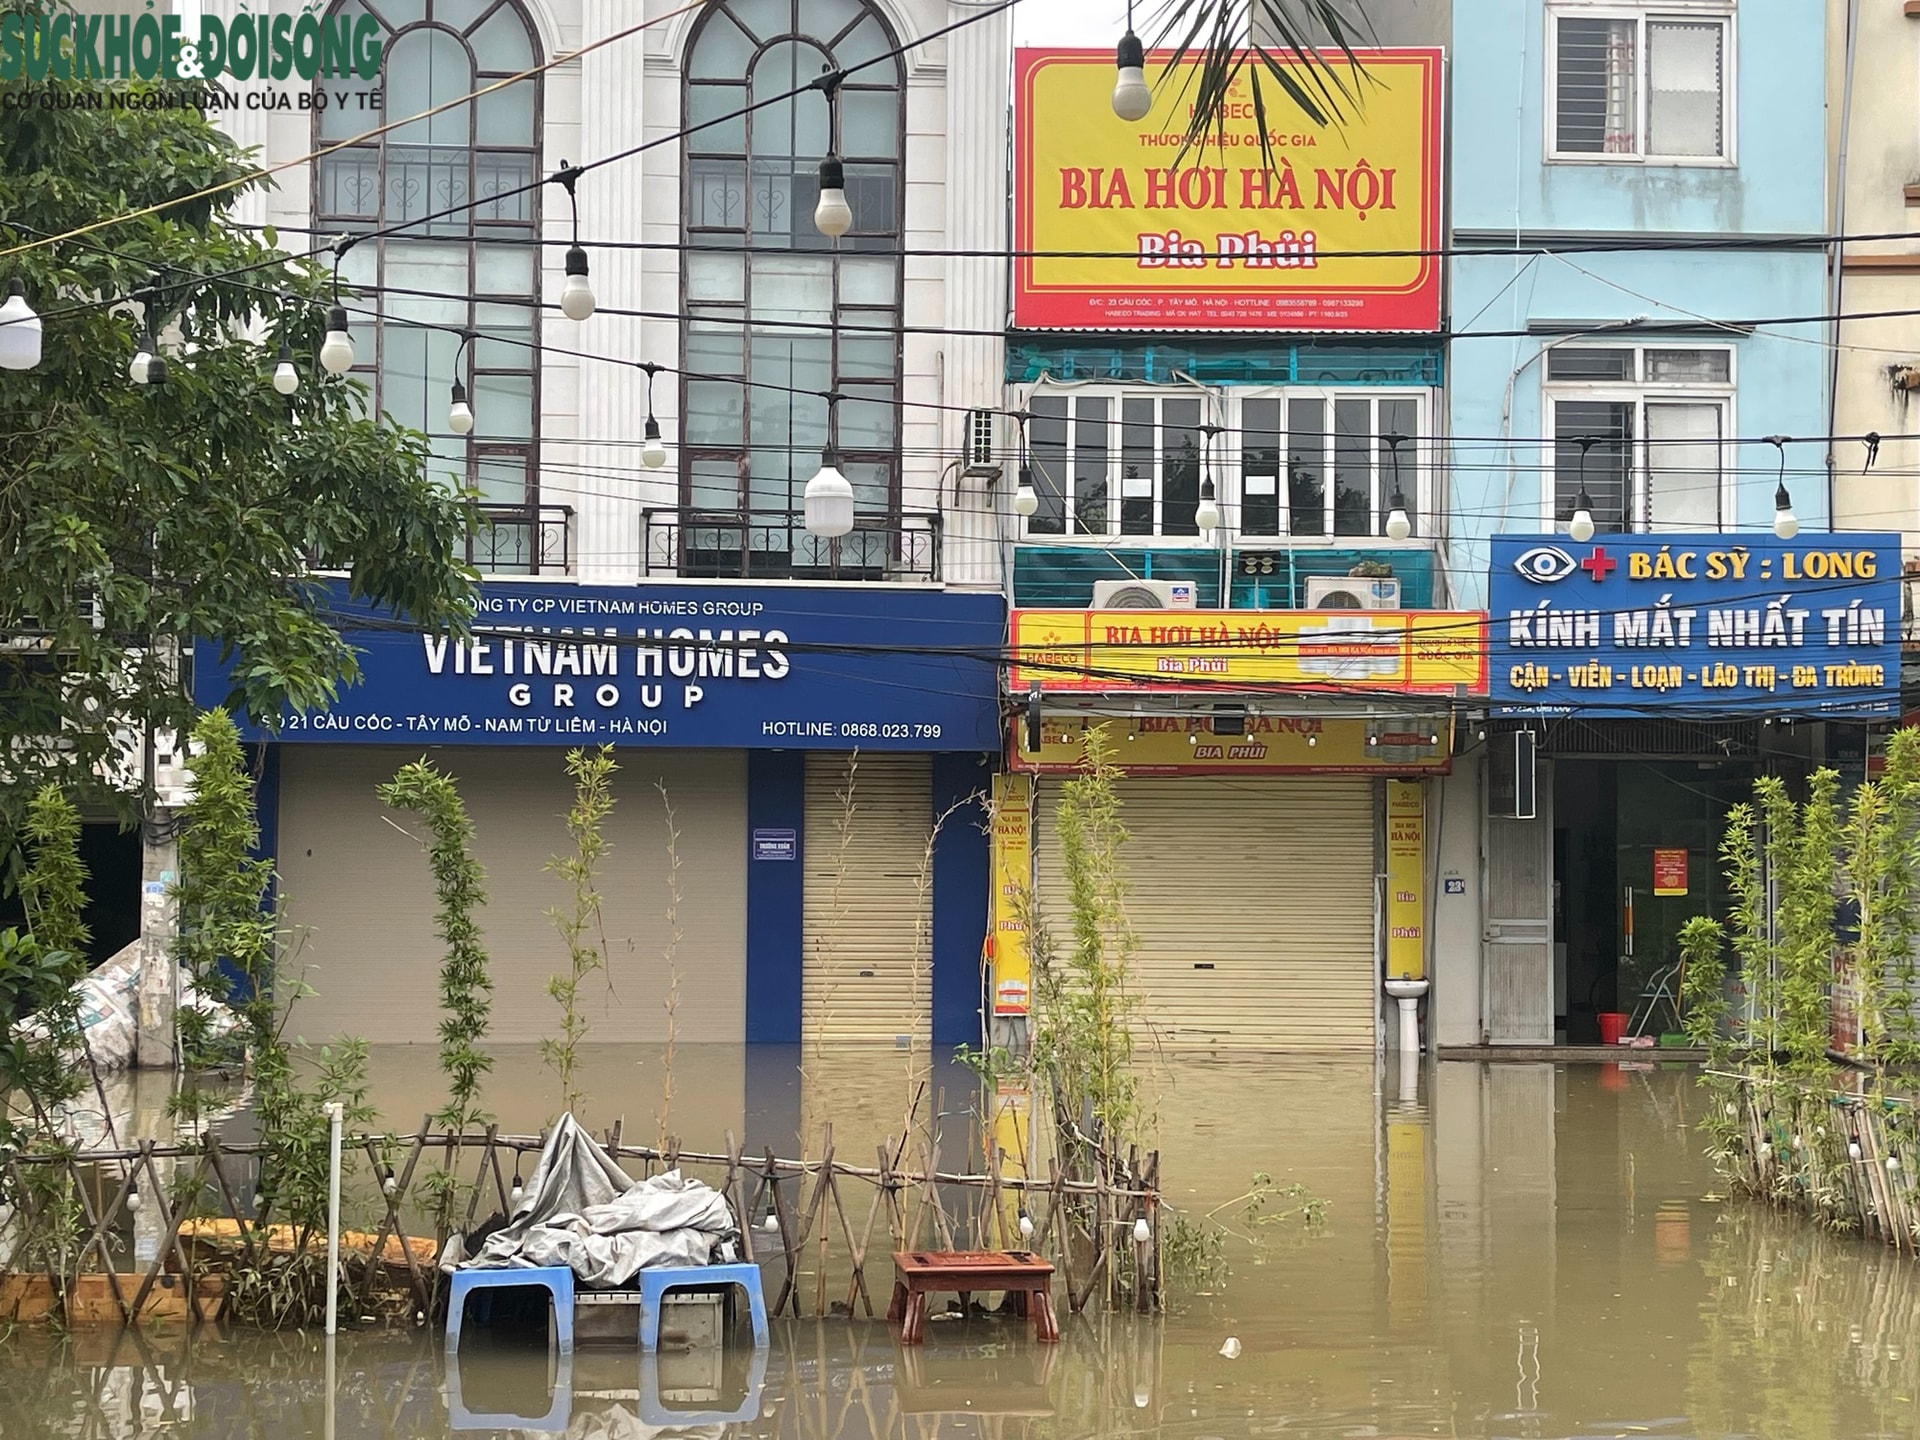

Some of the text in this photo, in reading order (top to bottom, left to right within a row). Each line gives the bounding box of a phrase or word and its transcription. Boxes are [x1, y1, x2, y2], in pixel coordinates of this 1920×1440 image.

[1291, 134, 1317, 148] GIA
[1059, 156, 1396, 221] BIA HƠI HÀ NỘI
[1136, 229, 1320, 270] Bia Phủi
[1628, 545, 1877, 580] BÁC SỸ : LONG
[507, 598, 529, 614] TY
[532, 598, 556, 615] CP
[559, 598, 634, 616] VIETNAM
[638, 600, 698, 616] HOMES
[702, 602, 763, 617] GROUP
[1508, 593, 1885, 648] KÍNH MẮT NHẤT TÍN
[1105, 626, 1144, 645] BIA
[1199, 620, 1231, 648] HÀ
[1237, 621, 1281, 656] NỘI
[423, 625, 790, 680] VIETNAM HOMES
[1156, 656, 1184, 673] Bia
[1510, 661, 1549, 692] CẬN
[1631, 665, 1682, 693] LOẠN
[1701, 662, 1738, 689] LÃO
[1743, 665, 1776, 692] THỊ
[508, 684, 704, 709] GROUP
[289, 715, 307, 730] 21
[313, 713, 352, 731] CẦU
[406, 715, 442, 733] TÂY
[444, 713, 471, 733] MỖ
[485, 716, 523, 733] NAM
[527, 714, 551, 733] TỪ
[555, 715, 595, 734] LIÊM
[609, 716, 633, 734] HÀ
[637, 717, 667, 737] NỘI
[762, 721, 941, 739] HOTLINE: 0868.023.799
[1194, 744, 1223, 759] BIA
[1391, 830, 1421, 844] HÀ NỘI
[1396, 891, 1417, 903] Bia
[1391, 926, 1421, 939] Phủi
